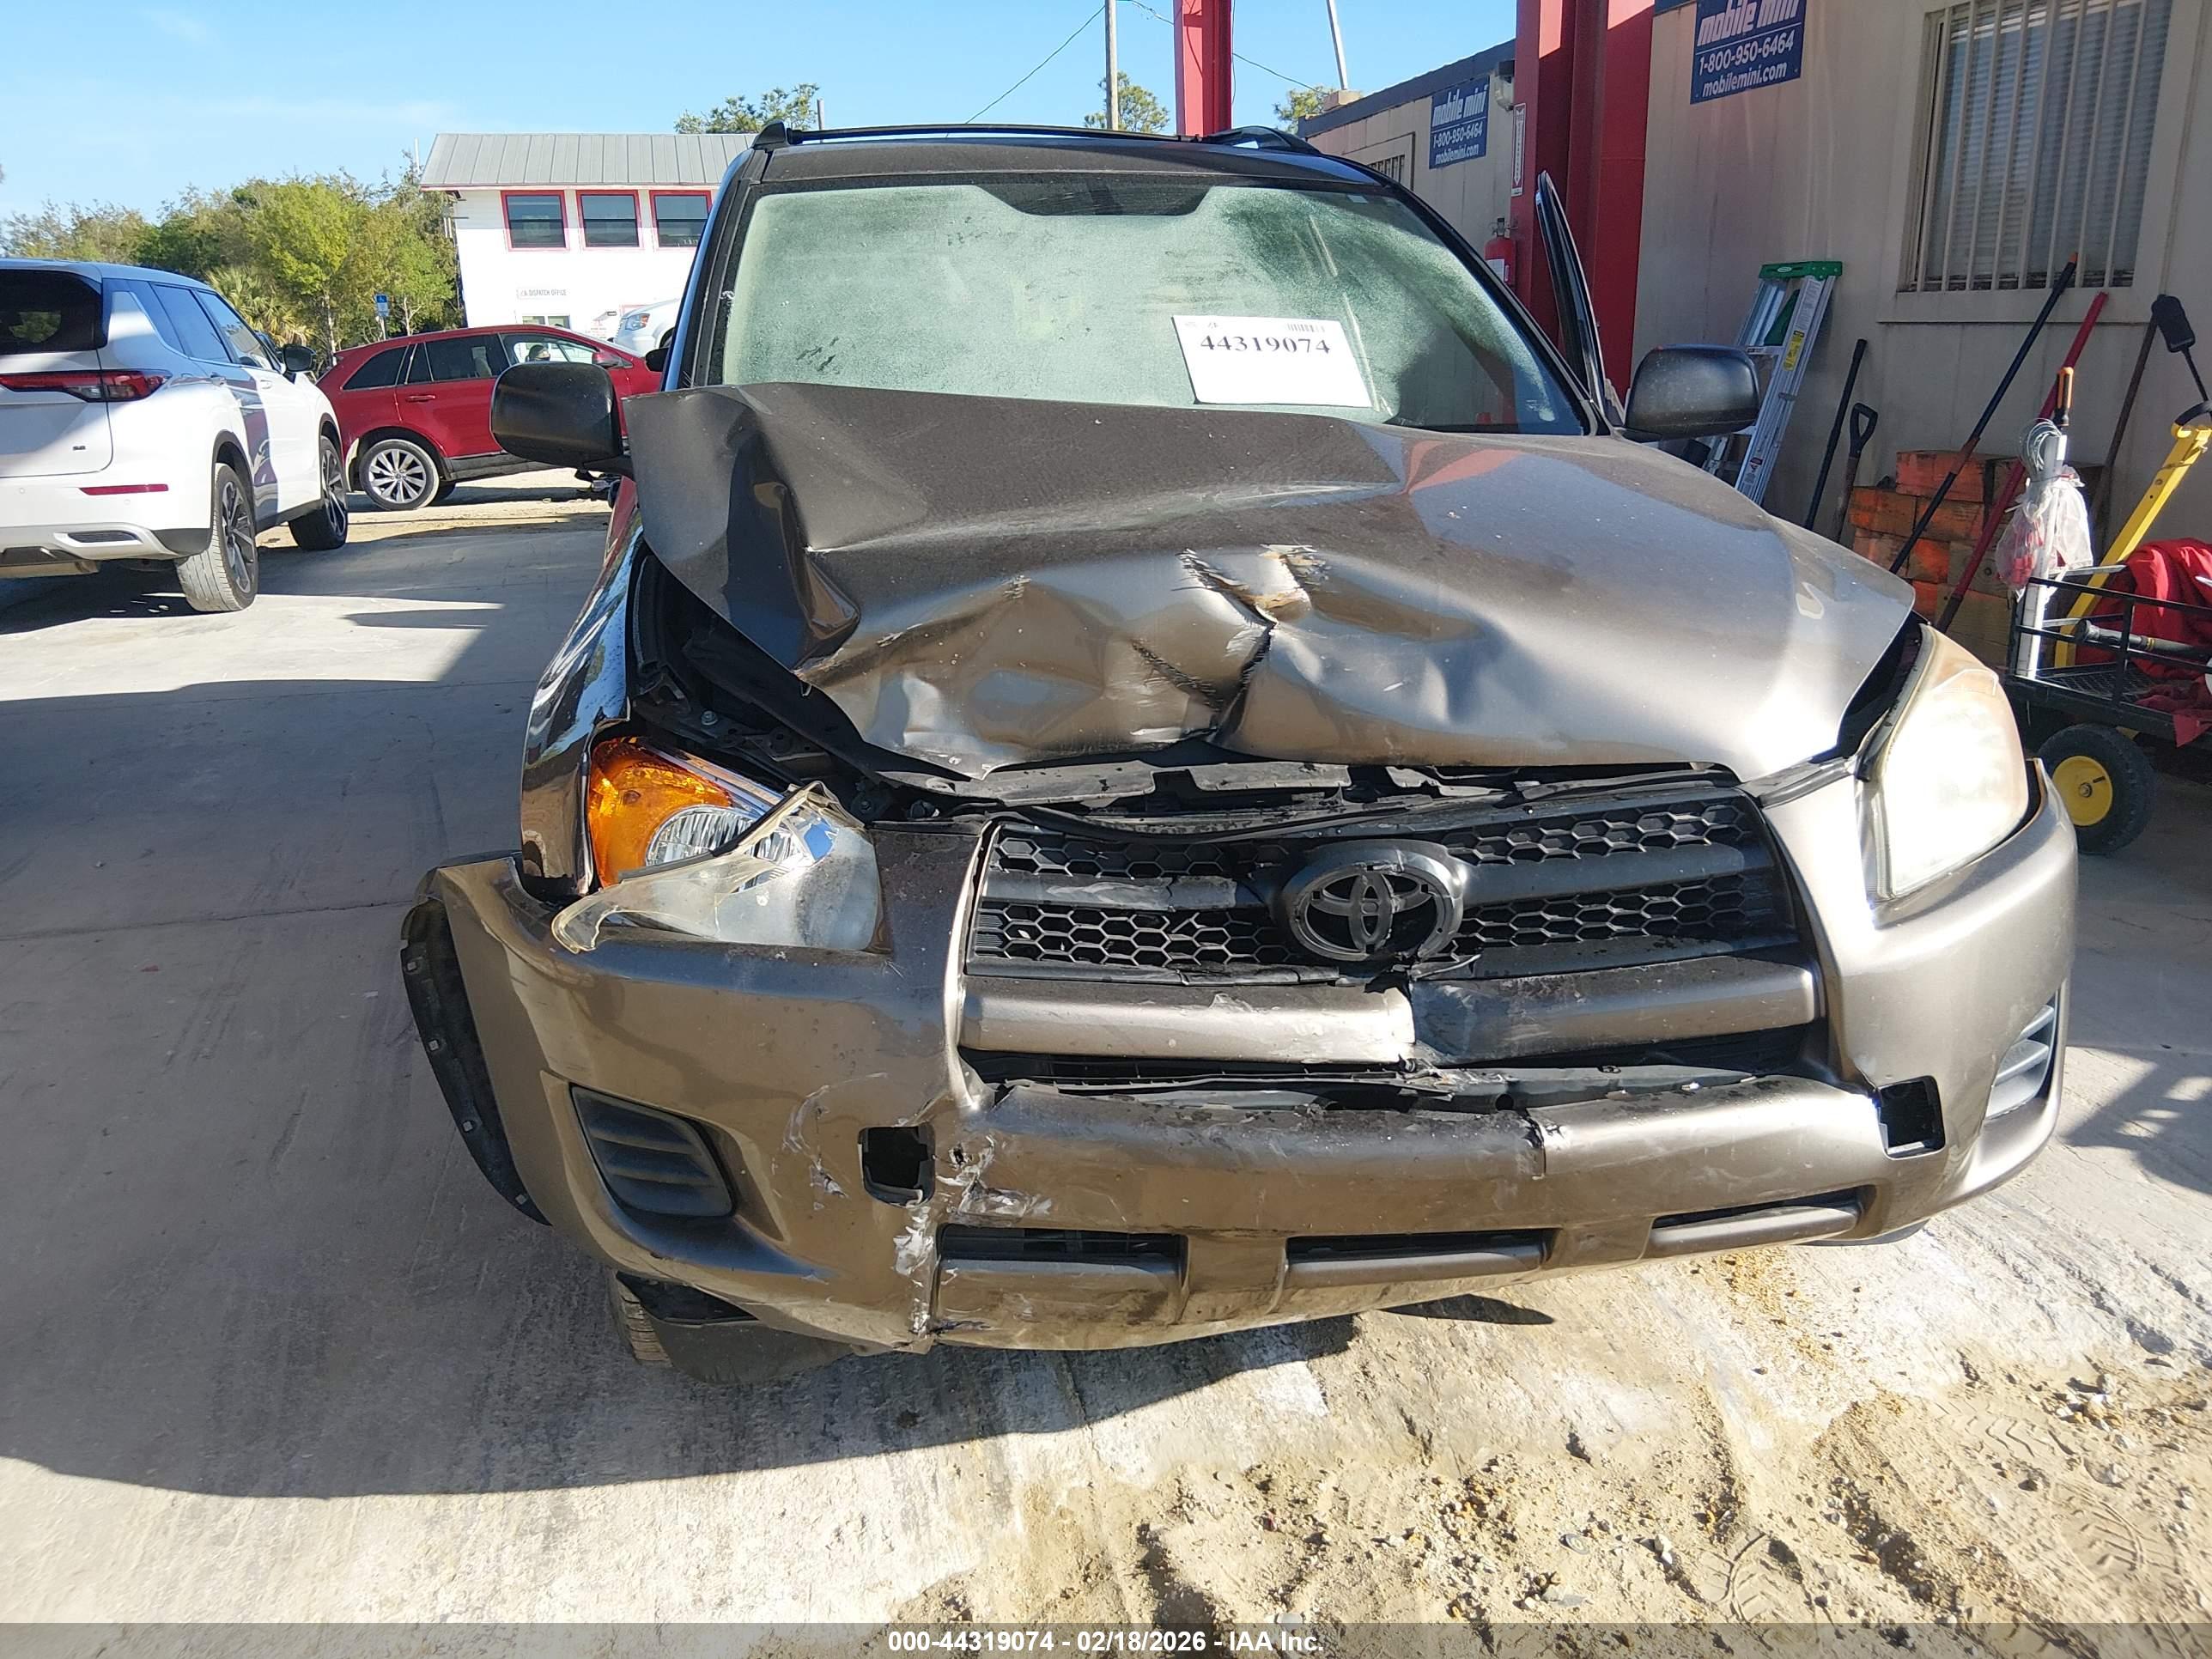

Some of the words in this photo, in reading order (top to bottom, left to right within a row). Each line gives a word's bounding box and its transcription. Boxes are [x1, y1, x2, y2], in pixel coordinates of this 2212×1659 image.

[1697, 0, 1757, 46] mobile
[1757, 0, 1800, 28] mini
[1699, 30, 1796, 76] 1-800-950-6464
[1702, 62, 1788, 98] mobilemini.com
[1432, 88, 1464, 128] mobile
[1463, 84, 1489, 118] mini
[1433, 121, 1483, 149] 1-800-950-6464
[1435, 143, 1480, 165] mobilemini.com
[1200, 334, 1332, 354] 44319074
